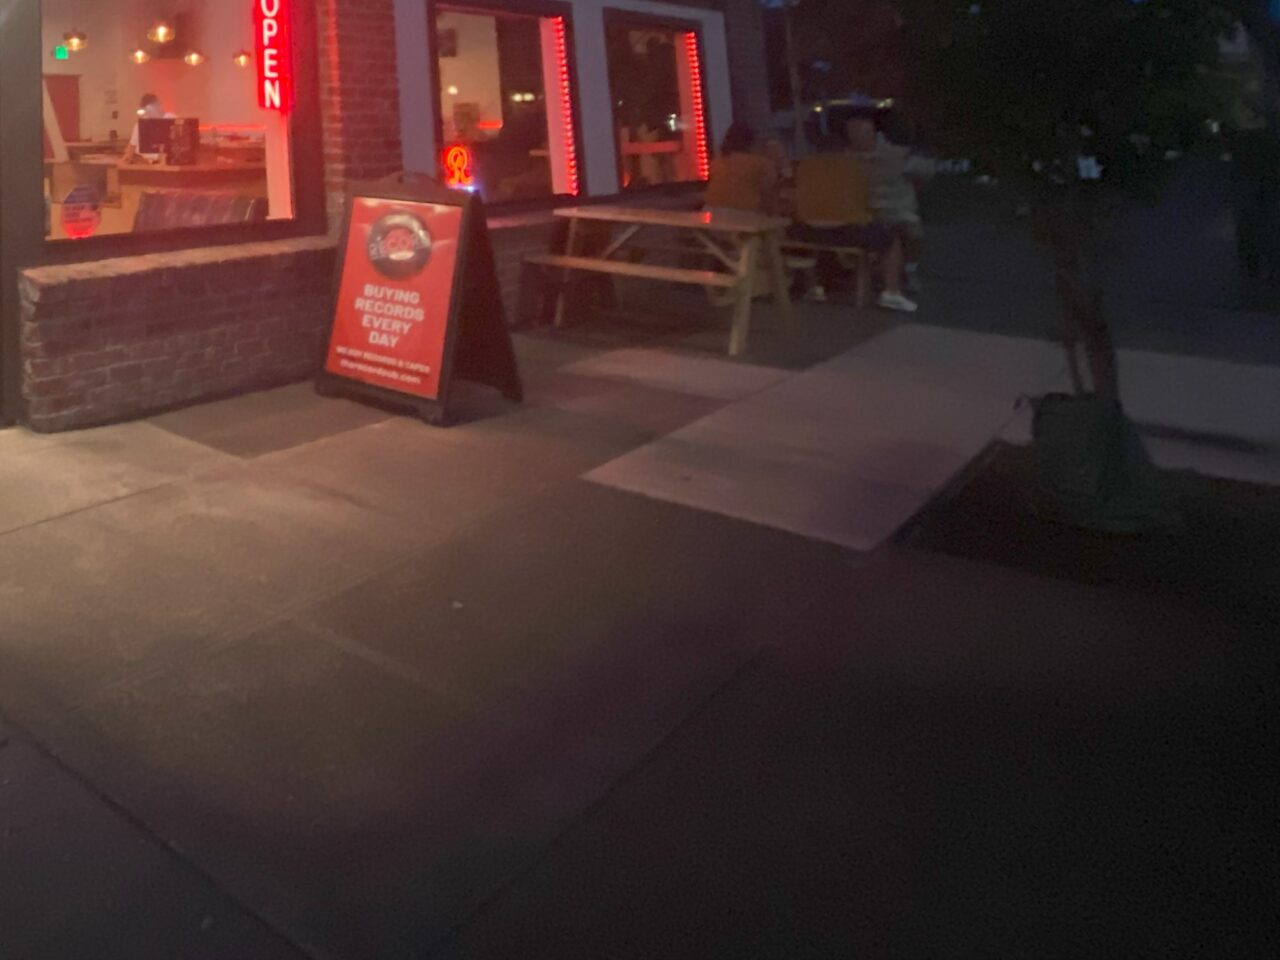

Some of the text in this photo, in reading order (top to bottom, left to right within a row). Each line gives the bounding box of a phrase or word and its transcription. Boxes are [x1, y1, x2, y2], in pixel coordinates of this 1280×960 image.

[364, 284, 420, 304] BUYING
[354, 297, 424, 321] RECORDS
[362, 314, 412, 334] EVERY
[368, 330, 399, 348] DAY
